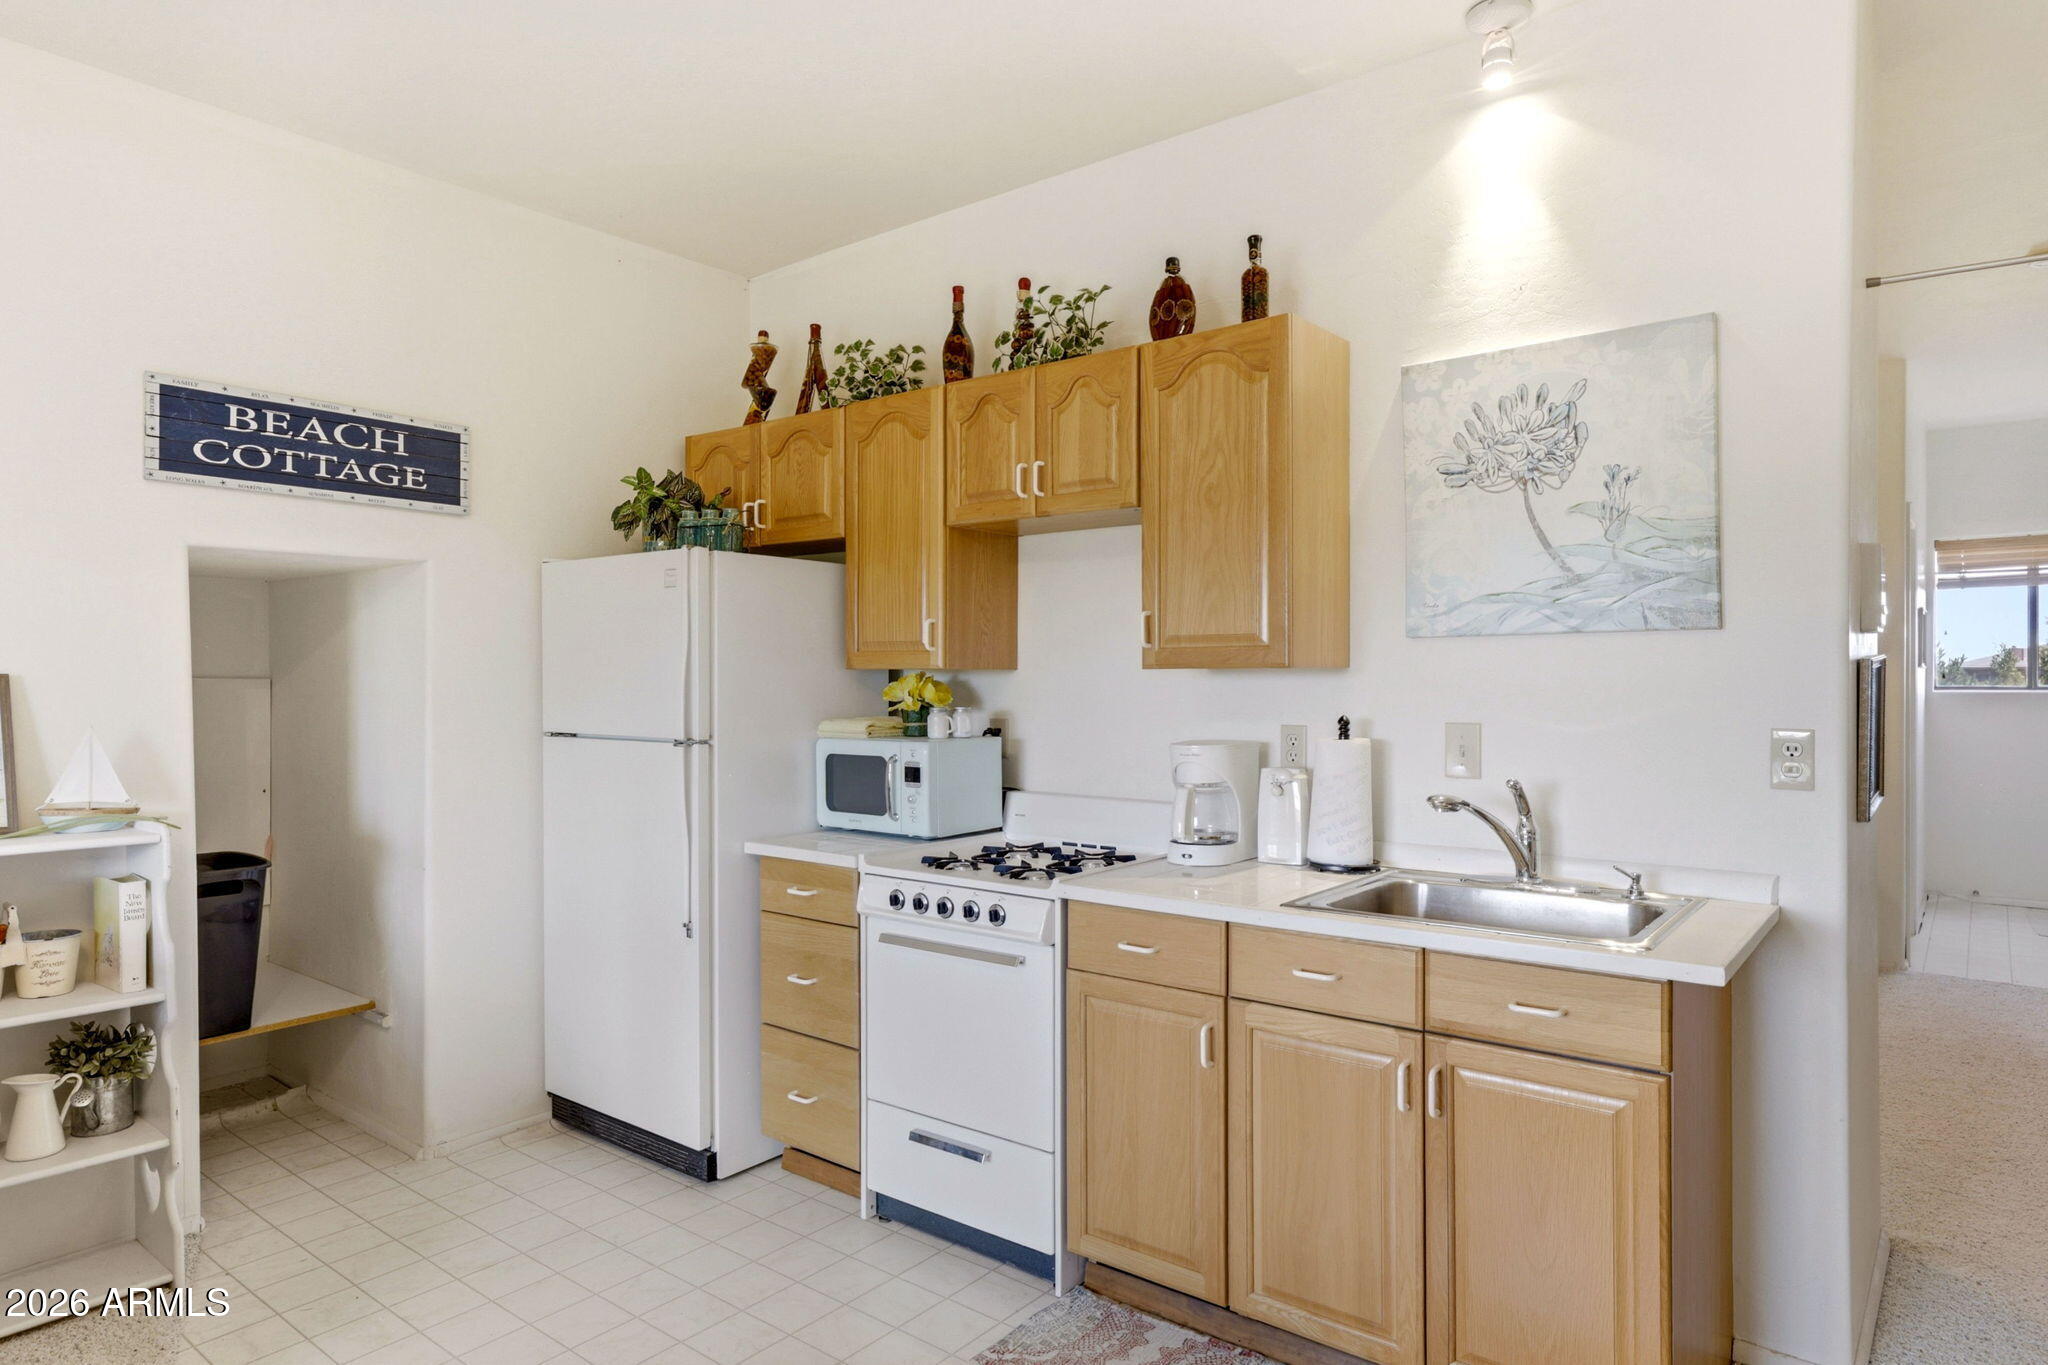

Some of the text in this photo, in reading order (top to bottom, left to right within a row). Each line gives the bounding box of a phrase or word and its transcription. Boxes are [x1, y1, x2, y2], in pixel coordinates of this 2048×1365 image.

[172, 379, 199, 387] FAMILY
[223, 403, 409, 456] BEACH
[192, 439, 428, 490] COTTAGE
